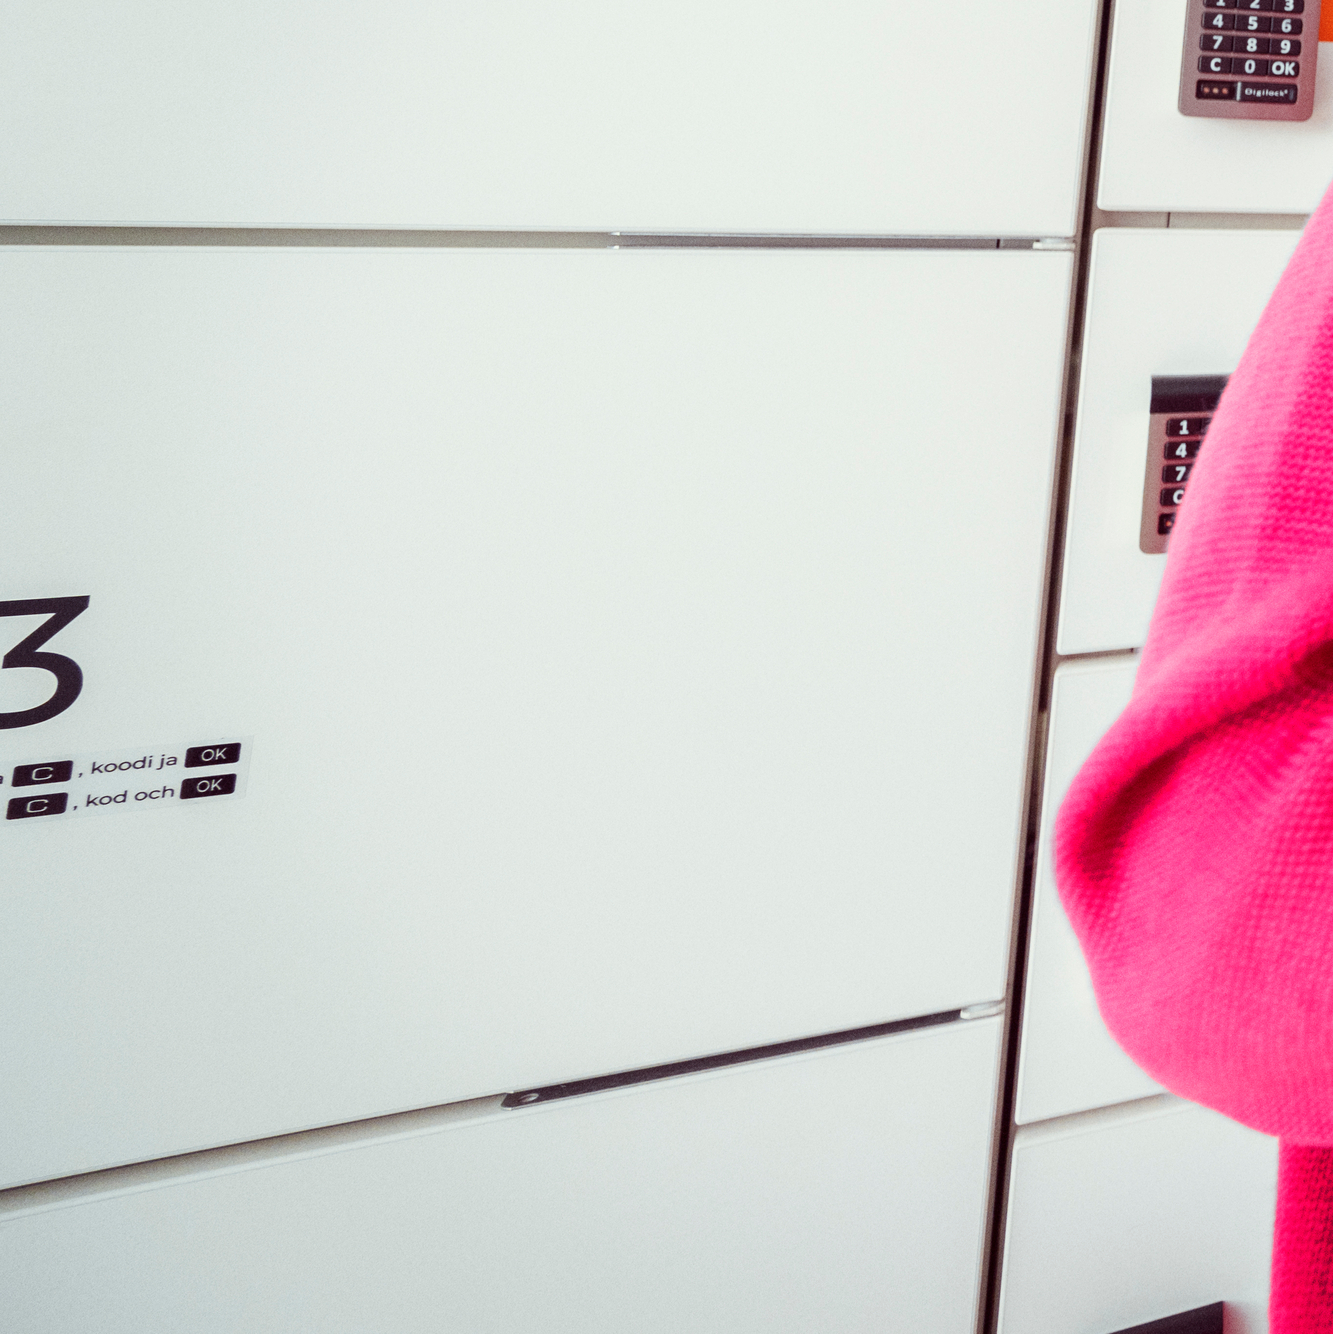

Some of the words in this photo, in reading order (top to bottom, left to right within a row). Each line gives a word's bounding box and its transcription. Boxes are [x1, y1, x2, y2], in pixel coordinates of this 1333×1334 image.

[1213, 14, 1224, 28] 4
[1248, 16, 1258, 31] 5
[1282, 19, 1292, 33] 6
[1213, 35, 1223, 50] 7
[1247, 38, 1257, 52] 8
[1281, 40, 1291, 54] 9
[1210, 58, 1222, 72] C
[1245, 60, 1256, 74] 0
[1272, 61, 1296, 76] OK
[1179, 420, 1189, 435] 1
[1175, 443, 1188, 458] 4
[1176, 466, 1187, 481] 7
[0, 594, 91, 730] 3
[91, 757, 152, 774] koodi
[157, 755, 178, 770] ja
[202, 748, 227, 762] OK
[86, 791, 127, 807] kod
[135, 786, 175, 801] och
[197, 779, 222, 793] OK
